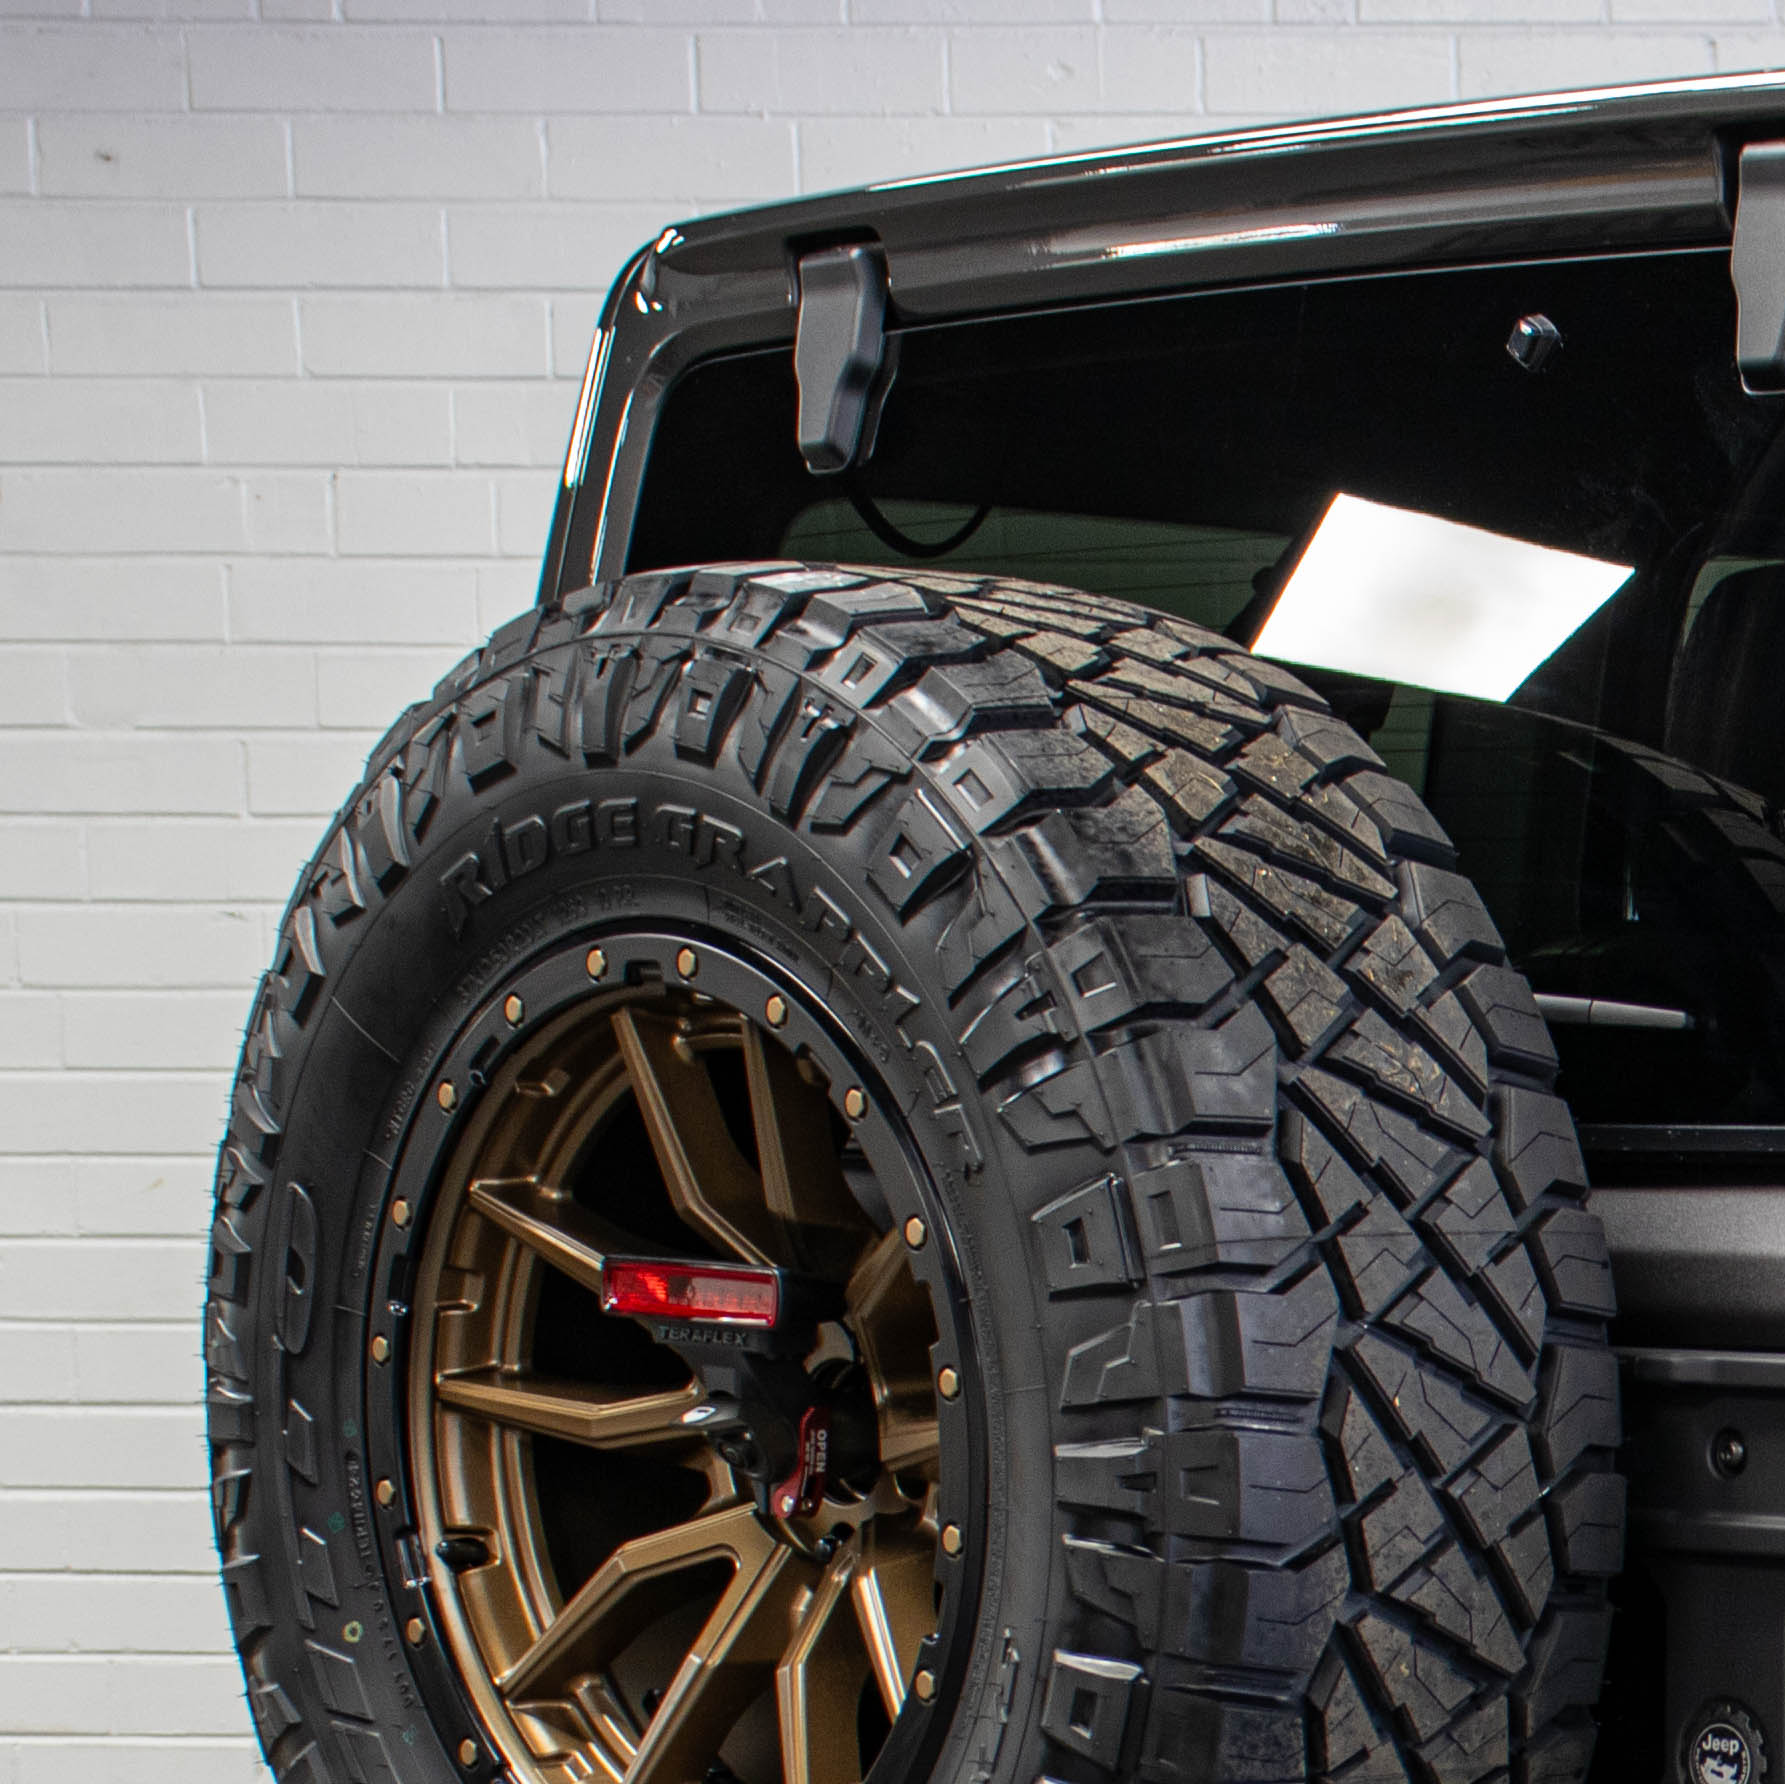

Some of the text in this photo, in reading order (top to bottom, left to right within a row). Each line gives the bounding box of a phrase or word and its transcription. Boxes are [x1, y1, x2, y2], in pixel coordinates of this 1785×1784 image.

[438, 796, 640, 942] RIDGE
[650, 802, 986, 1172] GRAPPLER
[657, 1325, 747, 1347] TERAFLEX
[815, 1429, 828, 1474] OPEN
[1701, 1732, 1741, 1756] Jeep
